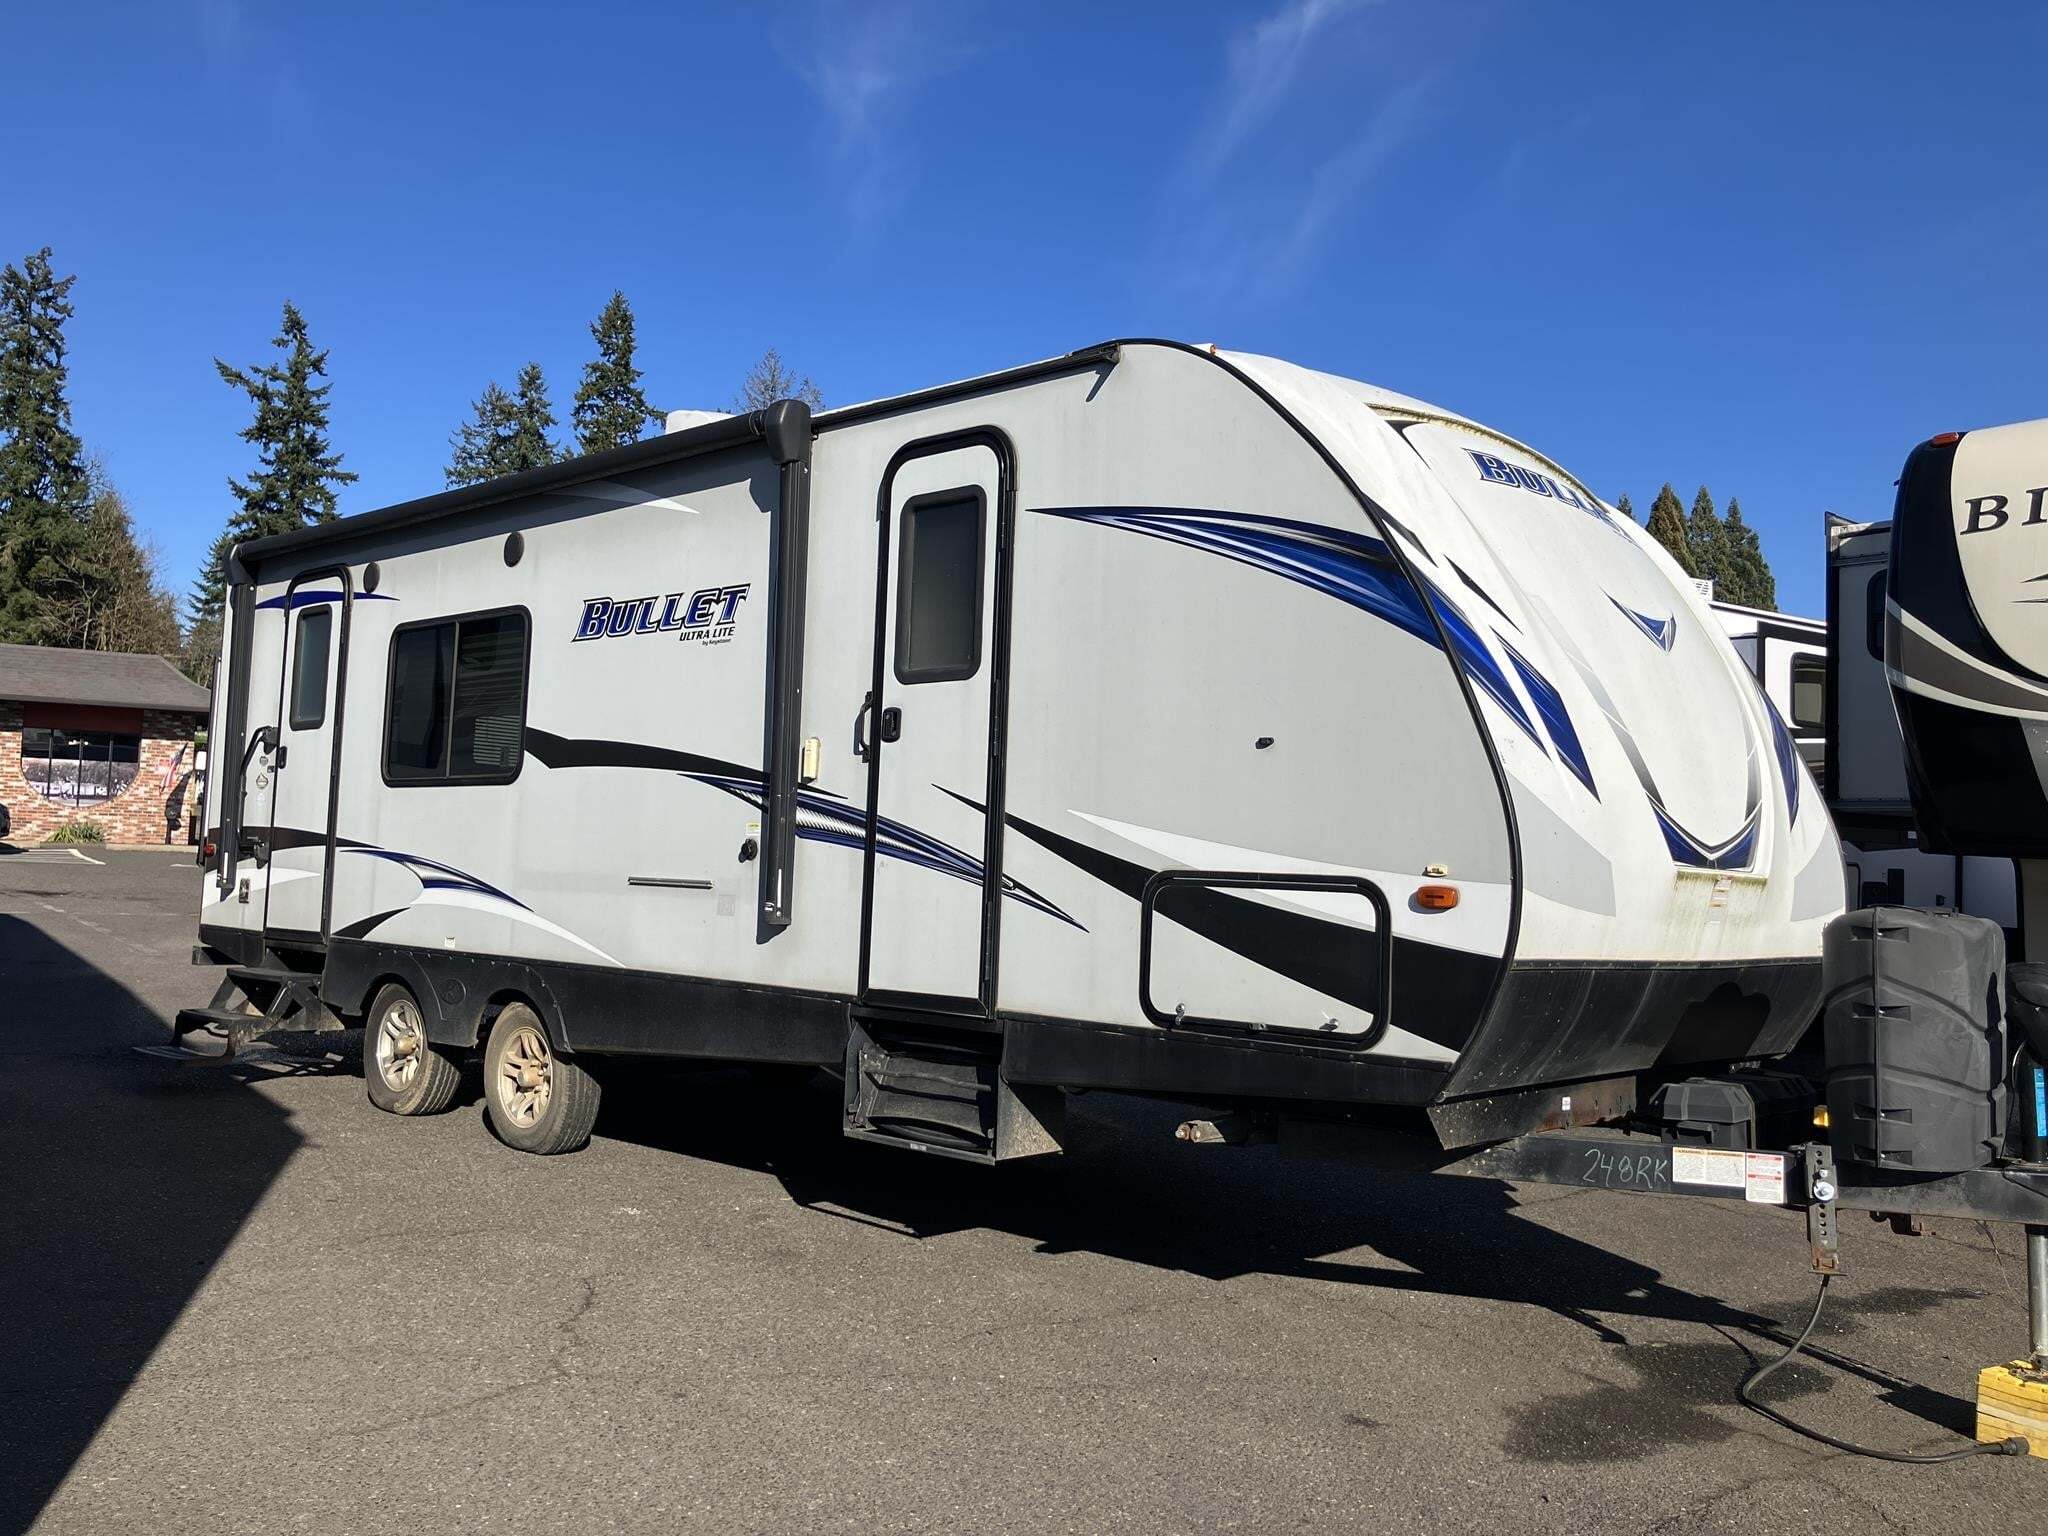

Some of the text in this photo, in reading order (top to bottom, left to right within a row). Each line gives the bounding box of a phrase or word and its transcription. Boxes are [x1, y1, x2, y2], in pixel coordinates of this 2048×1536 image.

[1460, 446, 1643, 552] BULL
[571, 583, 751, 643] BULLET
[679, 626, 736, 641] ULTRA LITE
[709, 638, 732, 646] Keys
[1582, 1148, 1667, 1189] 248RK
